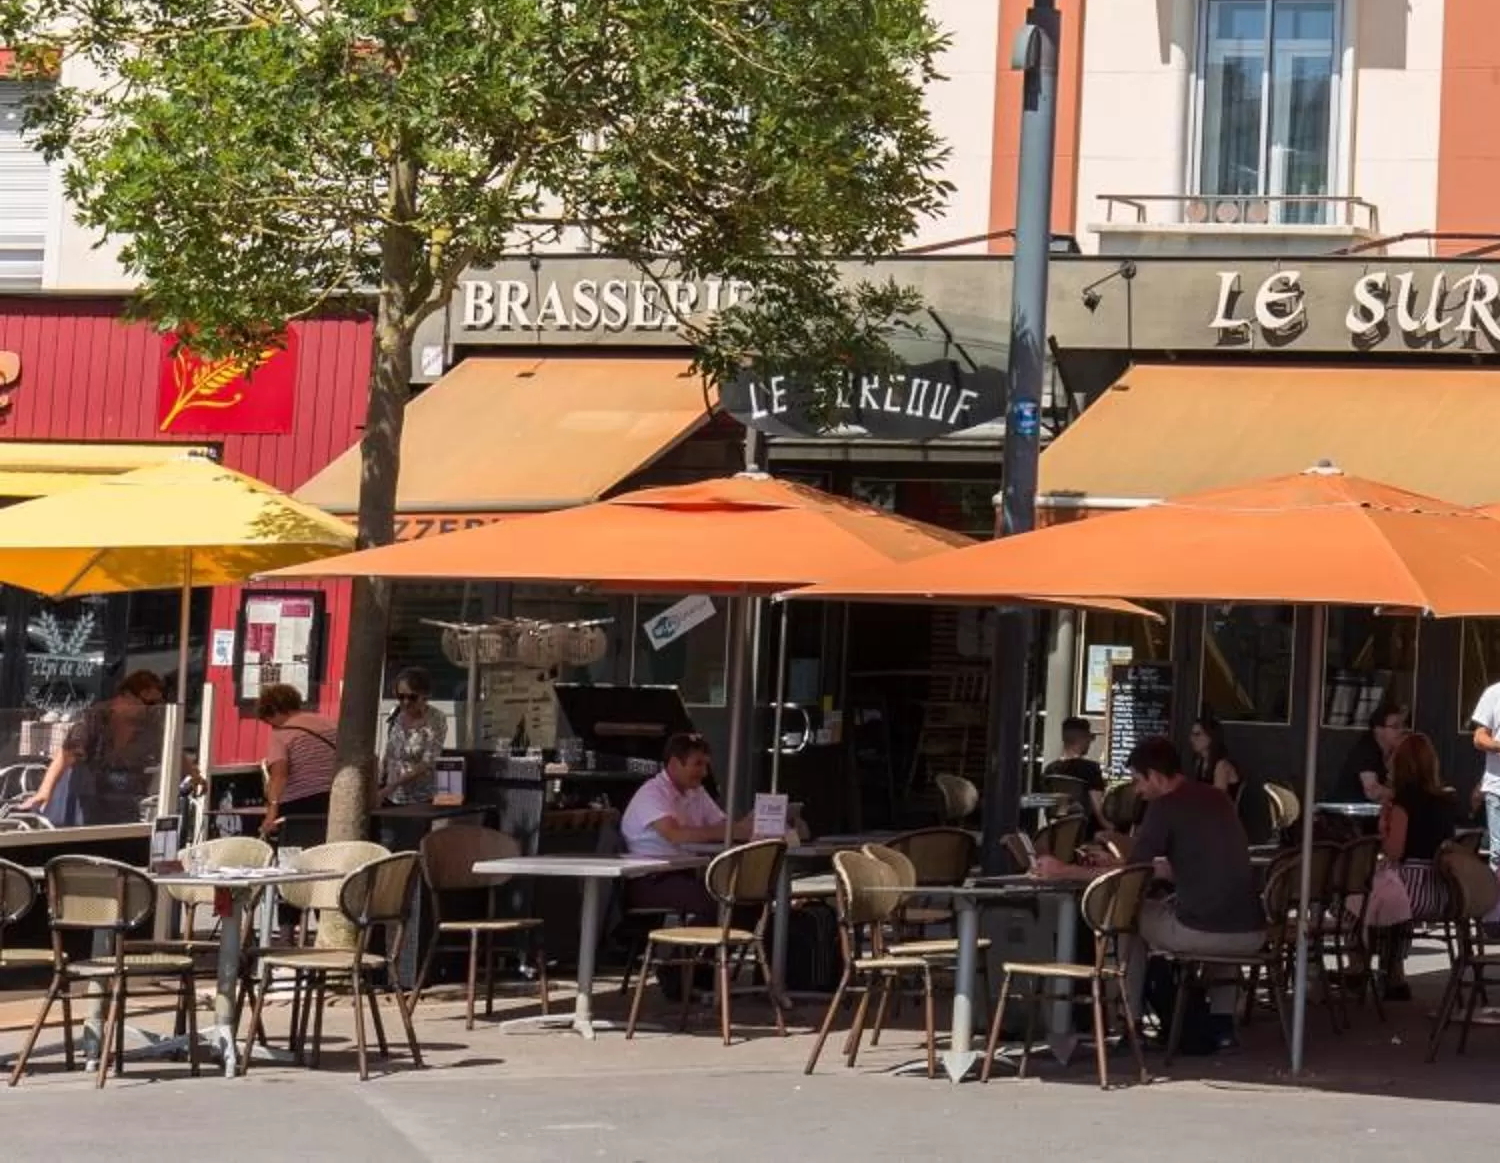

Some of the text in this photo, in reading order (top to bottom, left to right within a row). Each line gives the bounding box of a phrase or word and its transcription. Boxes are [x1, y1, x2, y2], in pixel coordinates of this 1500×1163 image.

[1209, 269, 1304, 329] LE
[749, 376, 787, 420] LE
[813, 372, 979, 424] URCOUF
